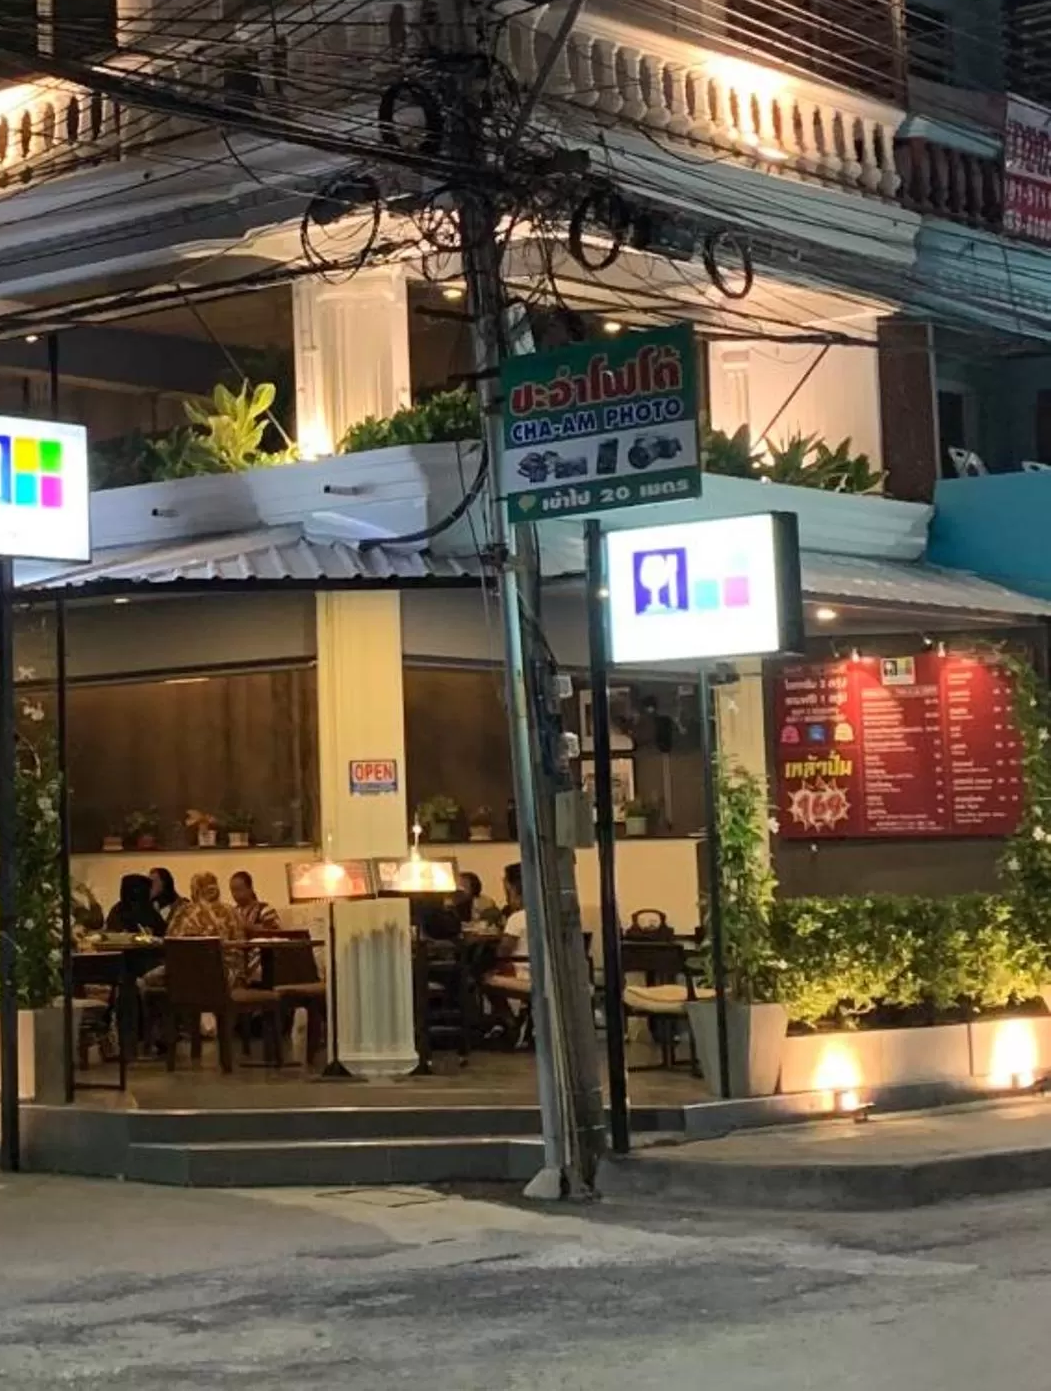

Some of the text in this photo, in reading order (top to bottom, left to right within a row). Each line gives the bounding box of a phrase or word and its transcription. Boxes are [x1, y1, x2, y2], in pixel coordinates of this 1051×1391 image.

[512, 397, 683, 443] CHA-AM PHOTO
[600, 485, 630, 503] 20
[640, 479, 689, 497] เมตร
[355, 763, 393, 781] OPEN
